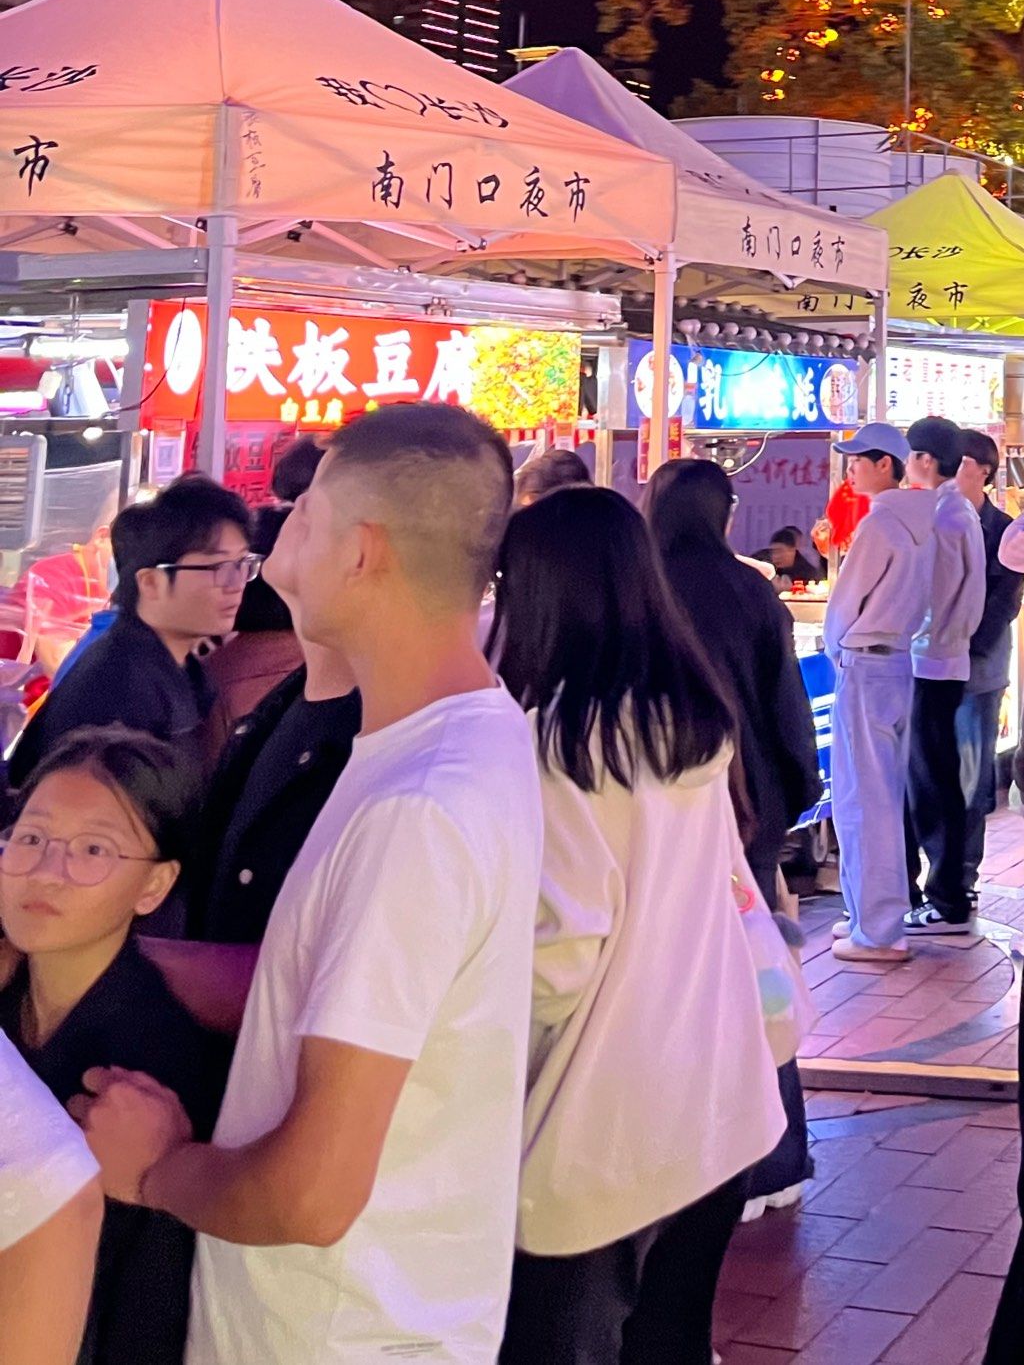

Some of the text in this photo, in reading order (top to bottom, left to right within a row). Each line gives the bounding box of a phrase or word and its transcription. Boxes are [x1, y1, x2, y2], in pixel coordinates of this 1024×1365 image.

[13, 134, 60, 198] 市
[371, 149, 592, 224] 南门口夜市
[741, 215, 847, 275] 南门口夜市
[900, 246, 965, 261] 长沙
